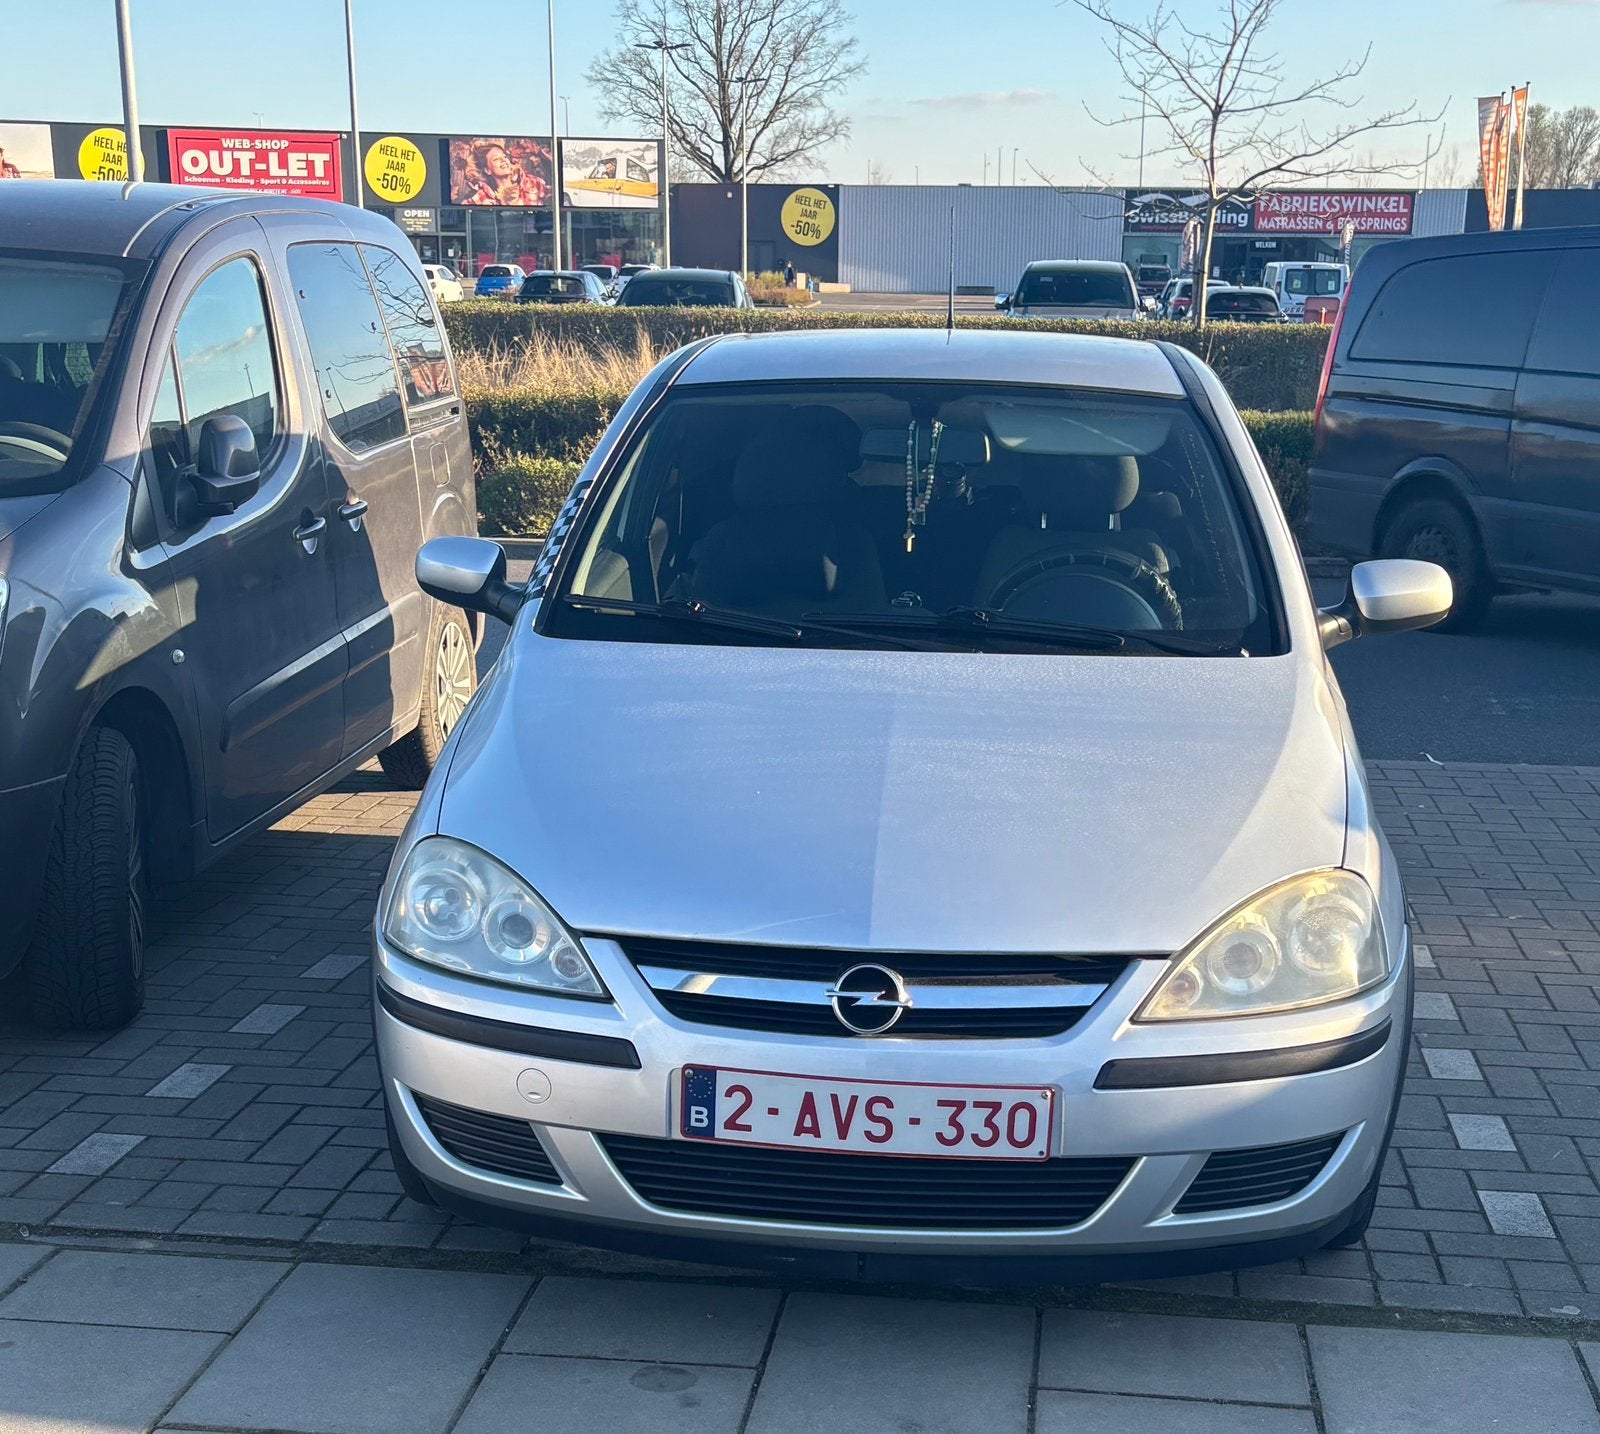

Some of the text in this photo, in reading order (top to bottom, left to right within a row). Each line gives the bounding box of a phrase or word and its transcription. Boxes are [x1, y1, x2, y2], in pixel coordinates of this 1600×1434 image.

[93, 135, 127, 153] HEEL HE
[221, 137, 290, 150] WEB-SHOP
[101, 151, 122, 166] JAAR
[379, 143, 416, 162] HEEL HET
[181, 149, 331, 178] OUT-LET
[385, 159, 406, 173] JAAR
[184, 175, 221, 184] Schoenen
[226, 177, 255, 186] Kleding
[260, 177, 281, 186] Sport
[288, 178, 330, 186] Accessoires
[376, 172, 411, 195] -50%
[794, 194, 828, 210] HEEL HET
[1259, 195, 1409, 213] FABRIEKSWINKEL
[404, 210, 430, 218] OPEN
[800, 208, 818, 220] JAAR
[1127, 209, 1249, 228] SwissBding
[790, 219, 822, 240] -50%
[1258, 217, 1323, 231] MATRASSEN
[1255, 241, 1277, 249] WELKOM
[689, 1104, 710, 1129] B
[722, 1083, 1038, 1150] 2-AVS-330
